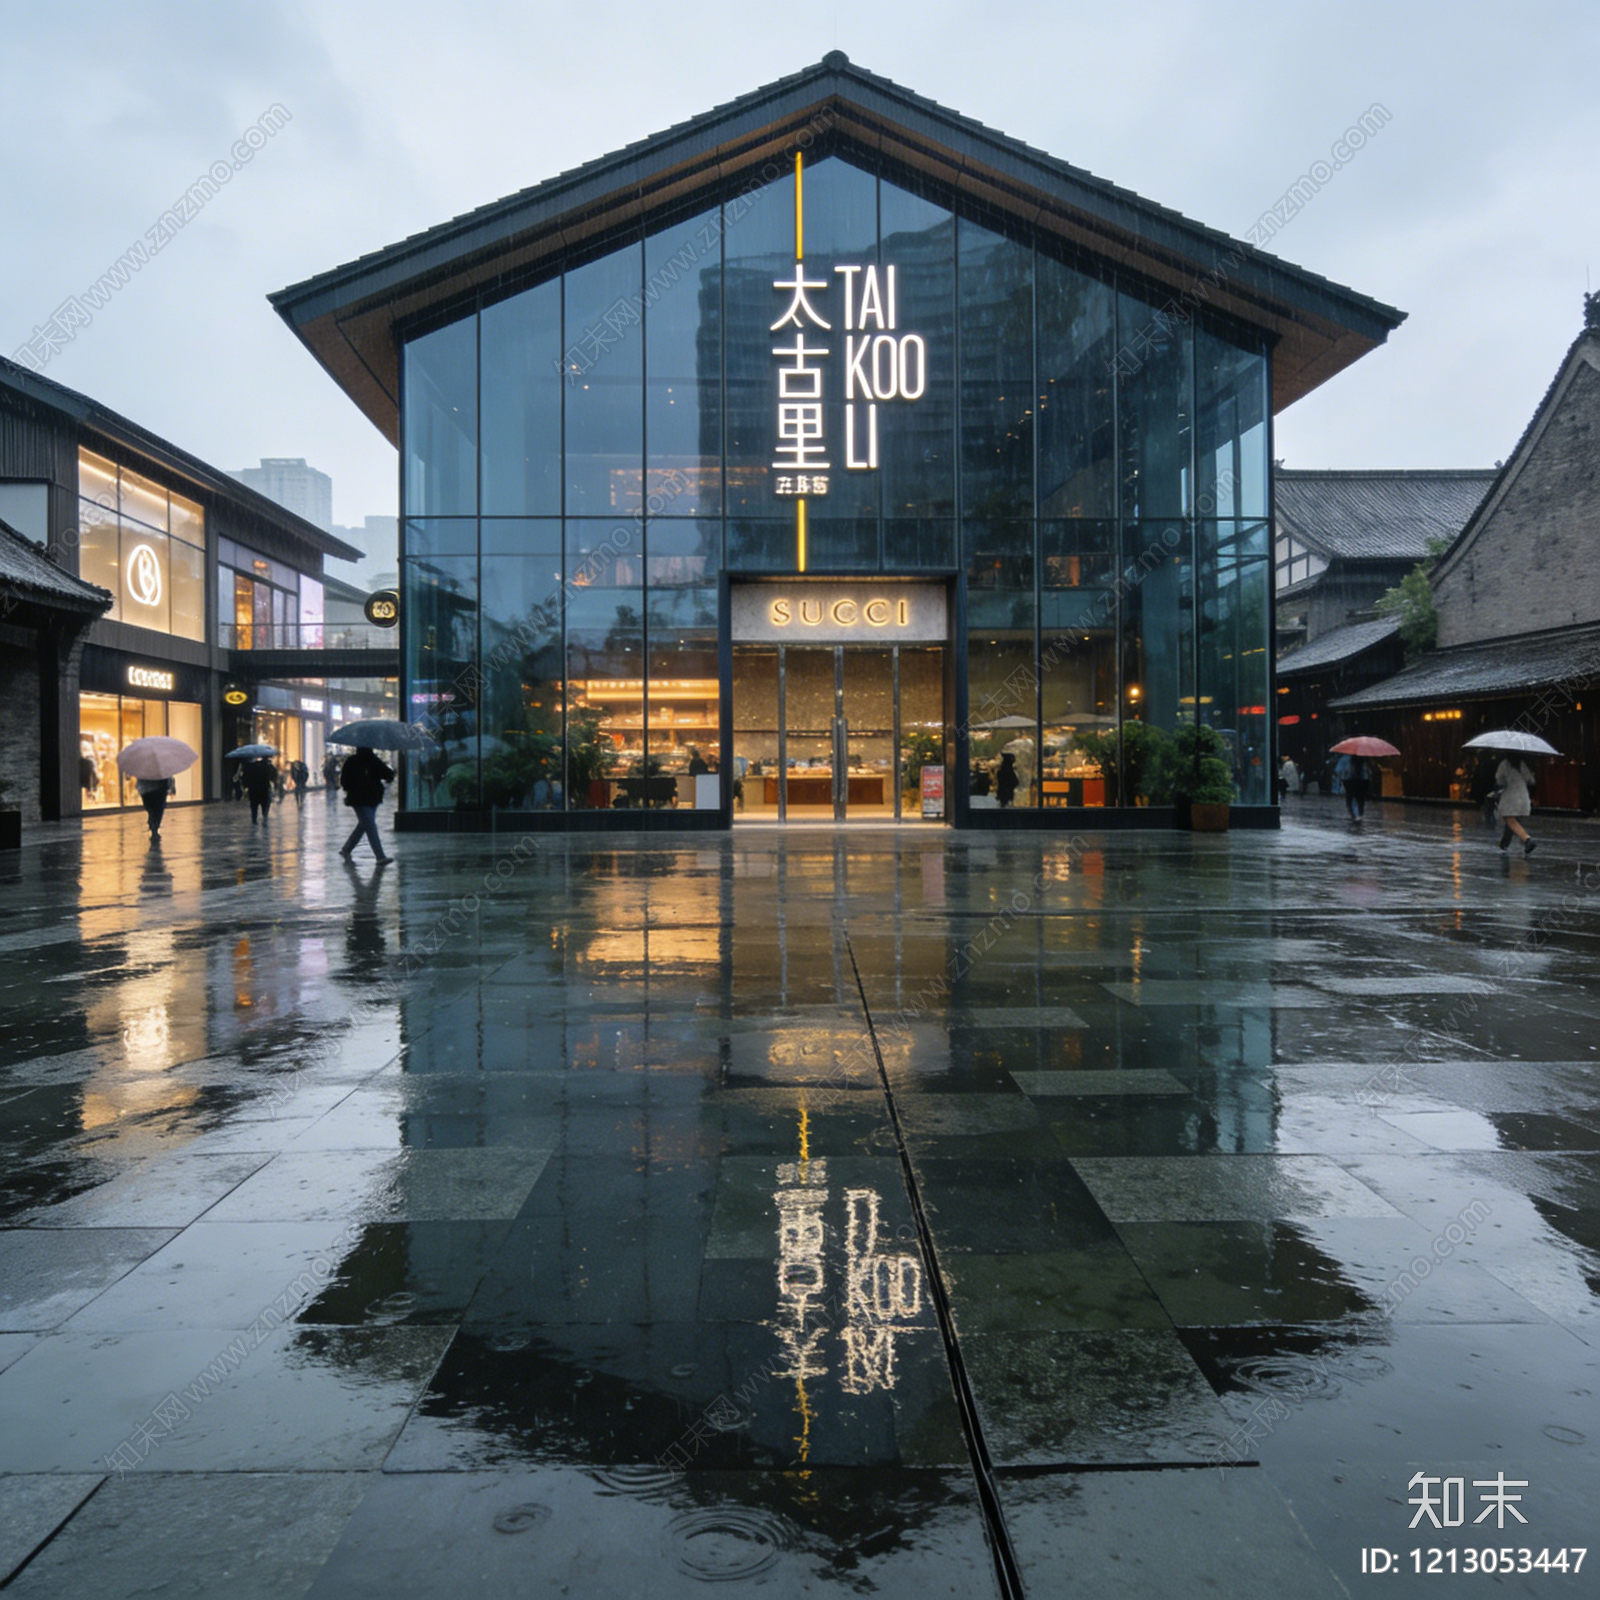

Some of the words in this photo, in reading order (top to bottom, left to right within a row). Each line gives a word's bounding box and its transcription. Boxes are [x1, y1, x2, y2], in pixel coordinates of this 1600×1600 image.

[834, 265, 895, 330] TAI
[770, 264, 831, 468] 太古里
[846, 334, 925, 399] KOO
[846, 403, 877, 468] LI
[770, 599, 908, 626] SUCCI
